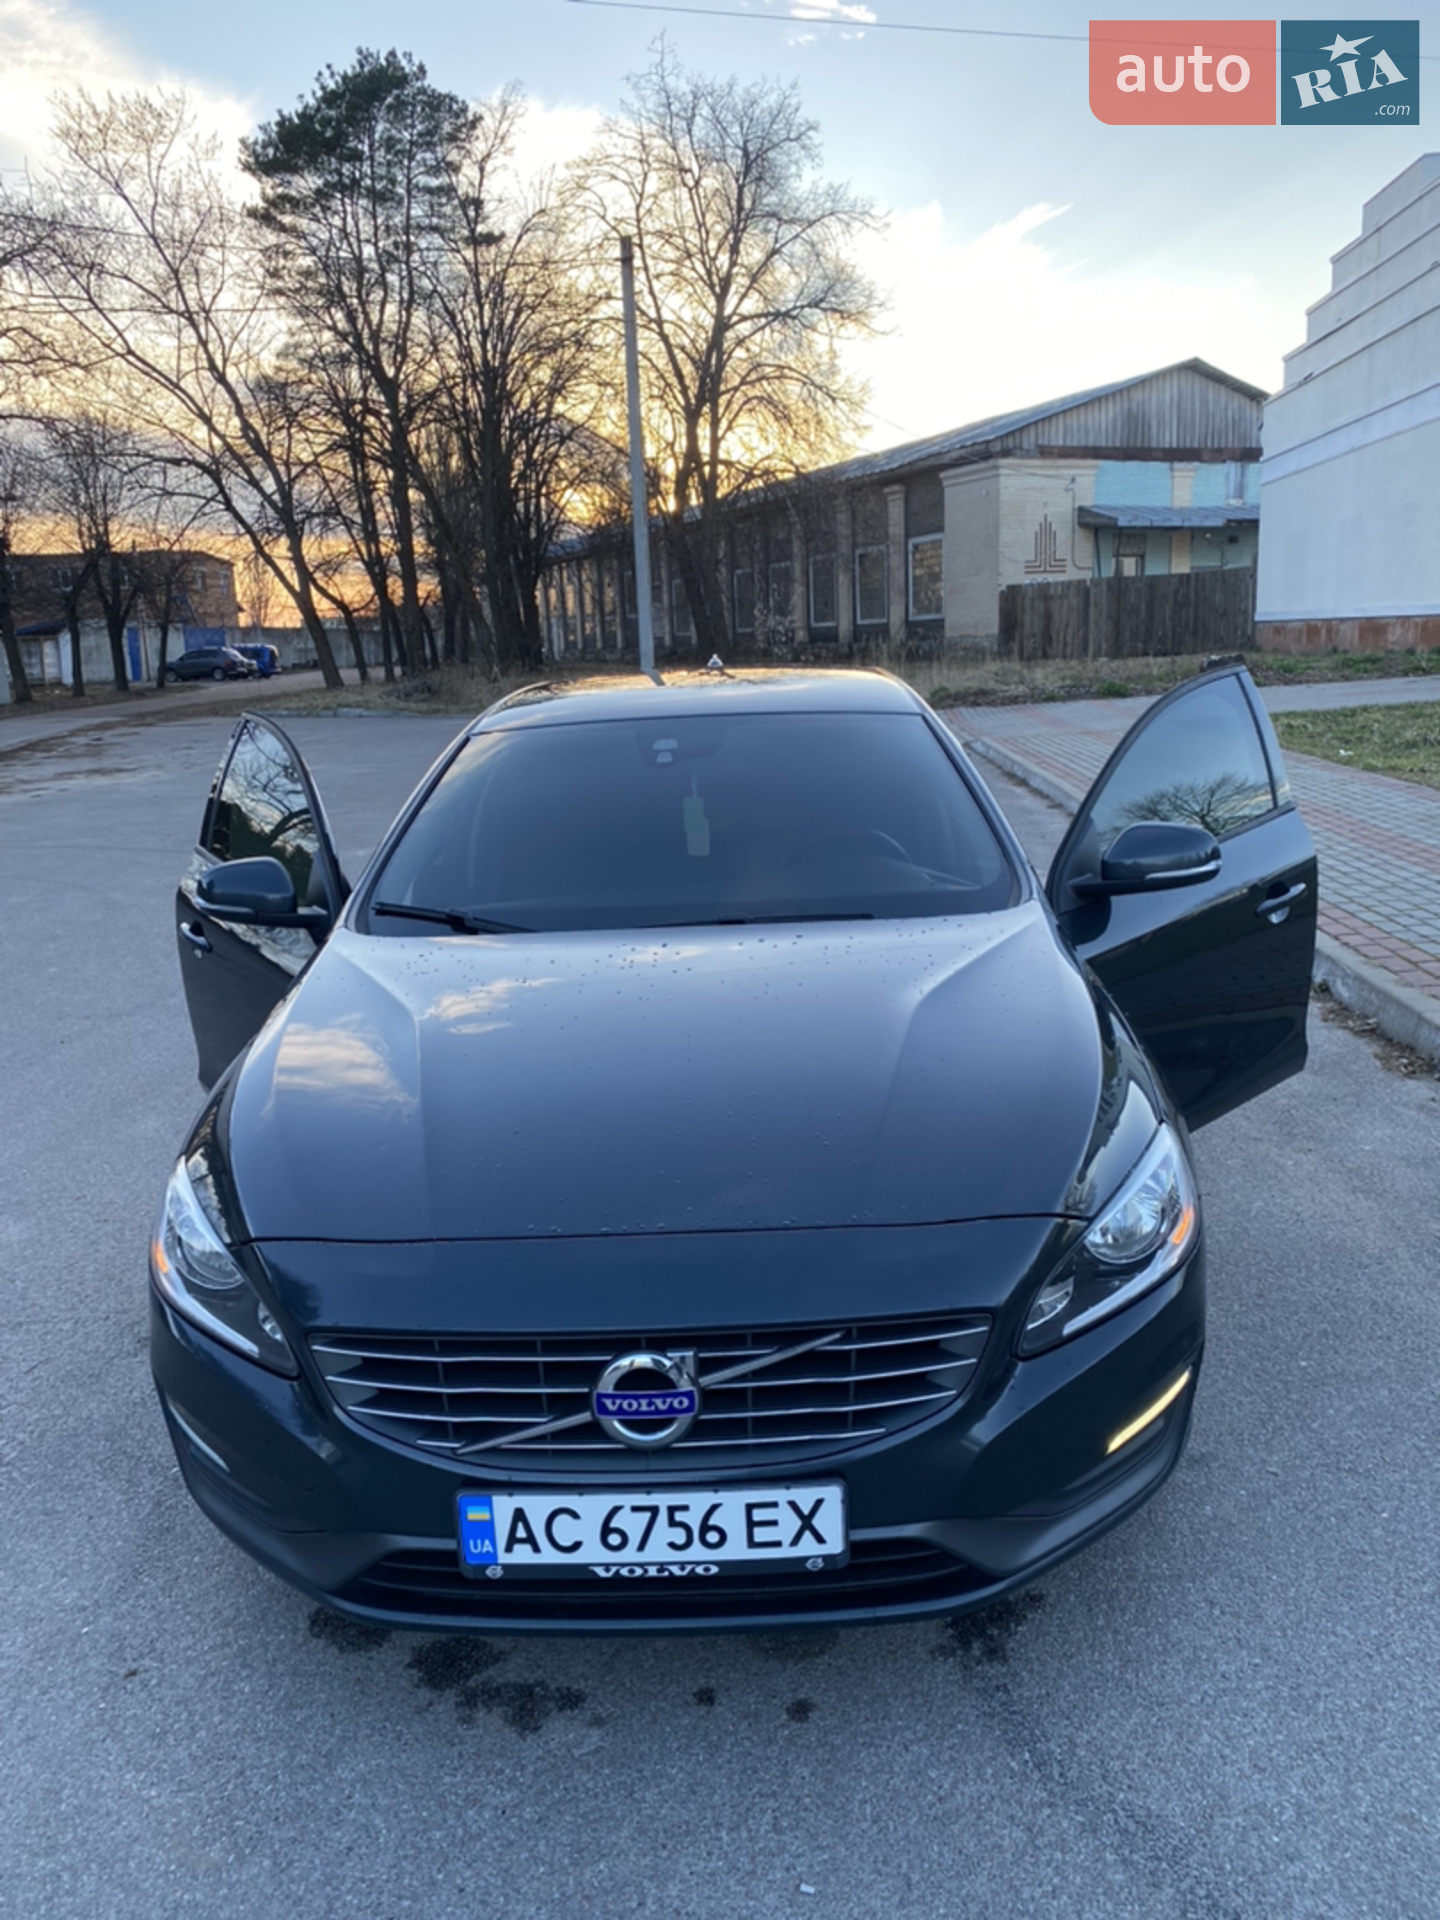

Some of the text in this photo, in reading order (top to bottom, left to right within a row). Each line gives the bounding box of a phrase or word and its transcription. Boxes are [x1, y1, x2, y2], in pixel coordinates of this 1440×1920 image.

[600, 1395, 690, 1412] VOLVO
[504, 1497, 828, 1554] AC 6756 EX
[469, 1538, 494, 1554] UA
[588, 1563, 720, 1578] VOLVO
